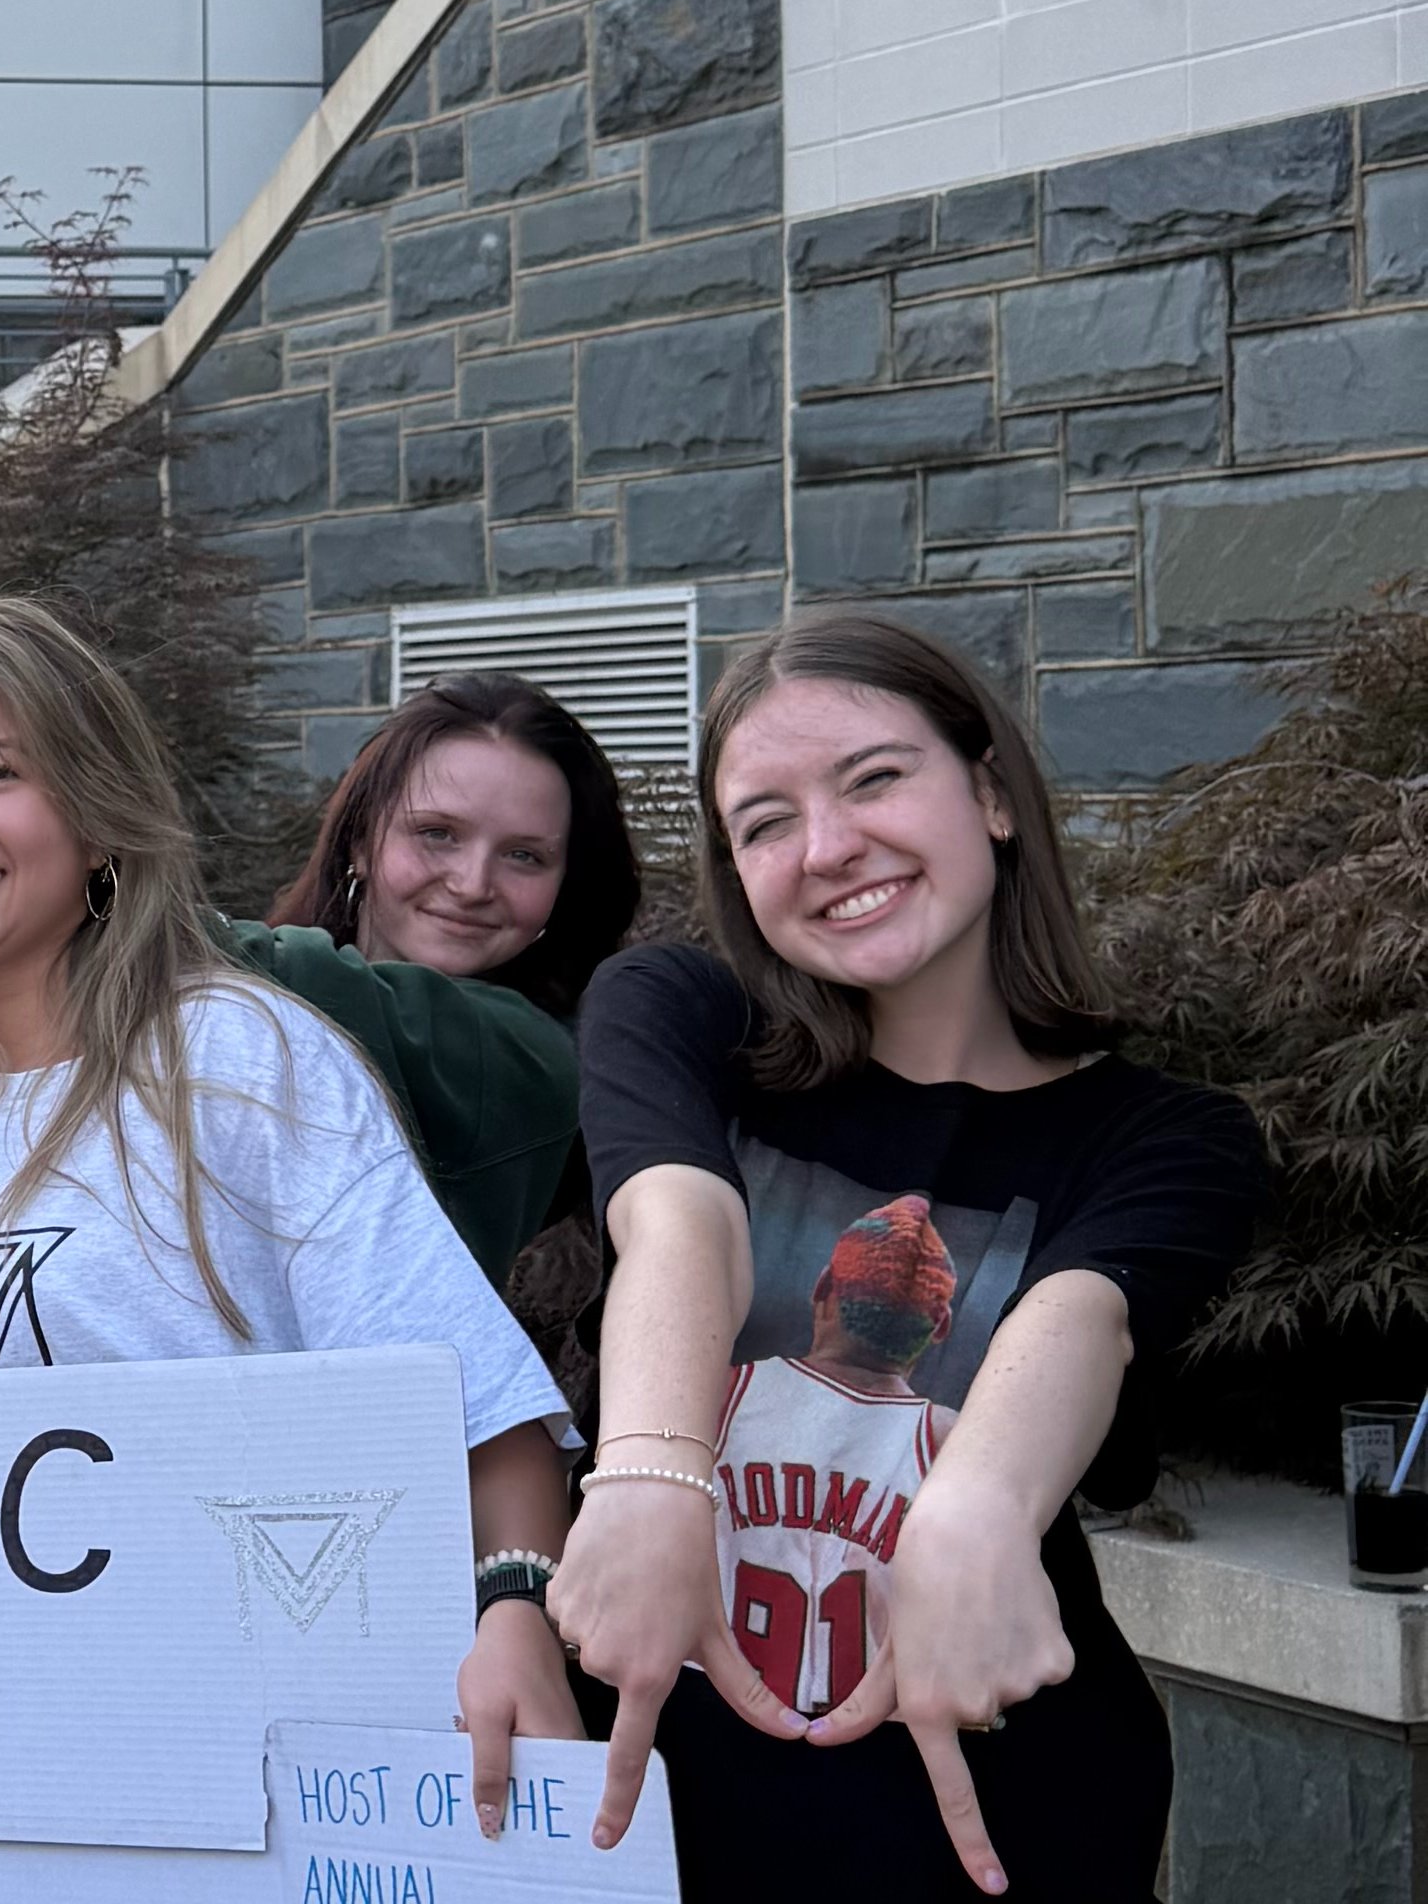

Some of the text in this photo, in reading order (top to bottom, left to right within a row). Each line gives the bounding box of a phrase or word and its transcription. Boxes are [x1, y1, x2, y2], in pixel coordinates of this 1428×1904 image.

[297, 1763, 571, 1838] HOST OF HE
